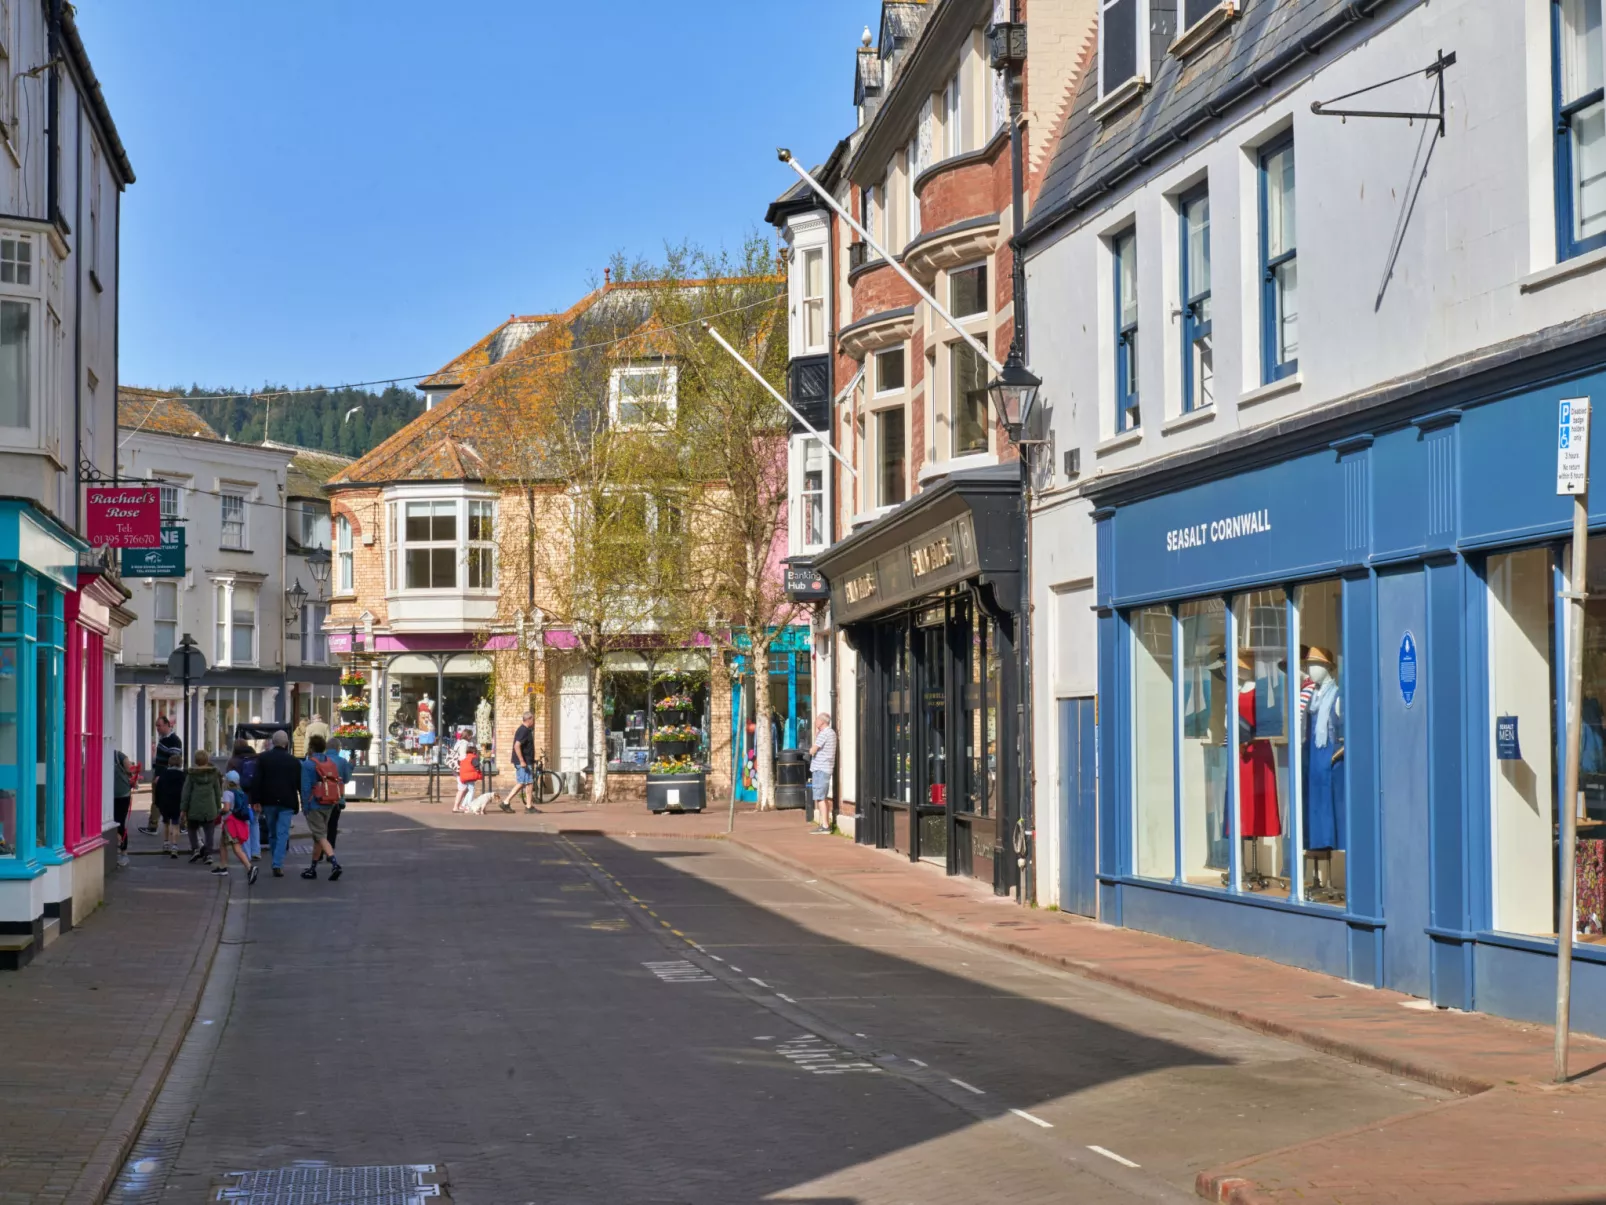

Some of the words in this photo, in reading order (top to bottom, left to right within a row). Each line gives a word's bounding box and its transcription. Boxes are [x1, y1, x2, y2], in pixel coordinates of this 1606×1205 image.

[1562, 404, 1569, 422] P
[90, 492, 156, 504] Rachael's
[106, 508, 140, 518] Rose
[116, 524, 132, 532] Tel:
[1166, 523, 1208, 552] SEASALT
[1210, 508, 1271, 542] CORNWALL
[94, 534, 120, 544] 01395
[788, 571, 822, 581] Banking
[788, 582, 806, 590] Hub
[1499, 730, 1514, 740] MEN
